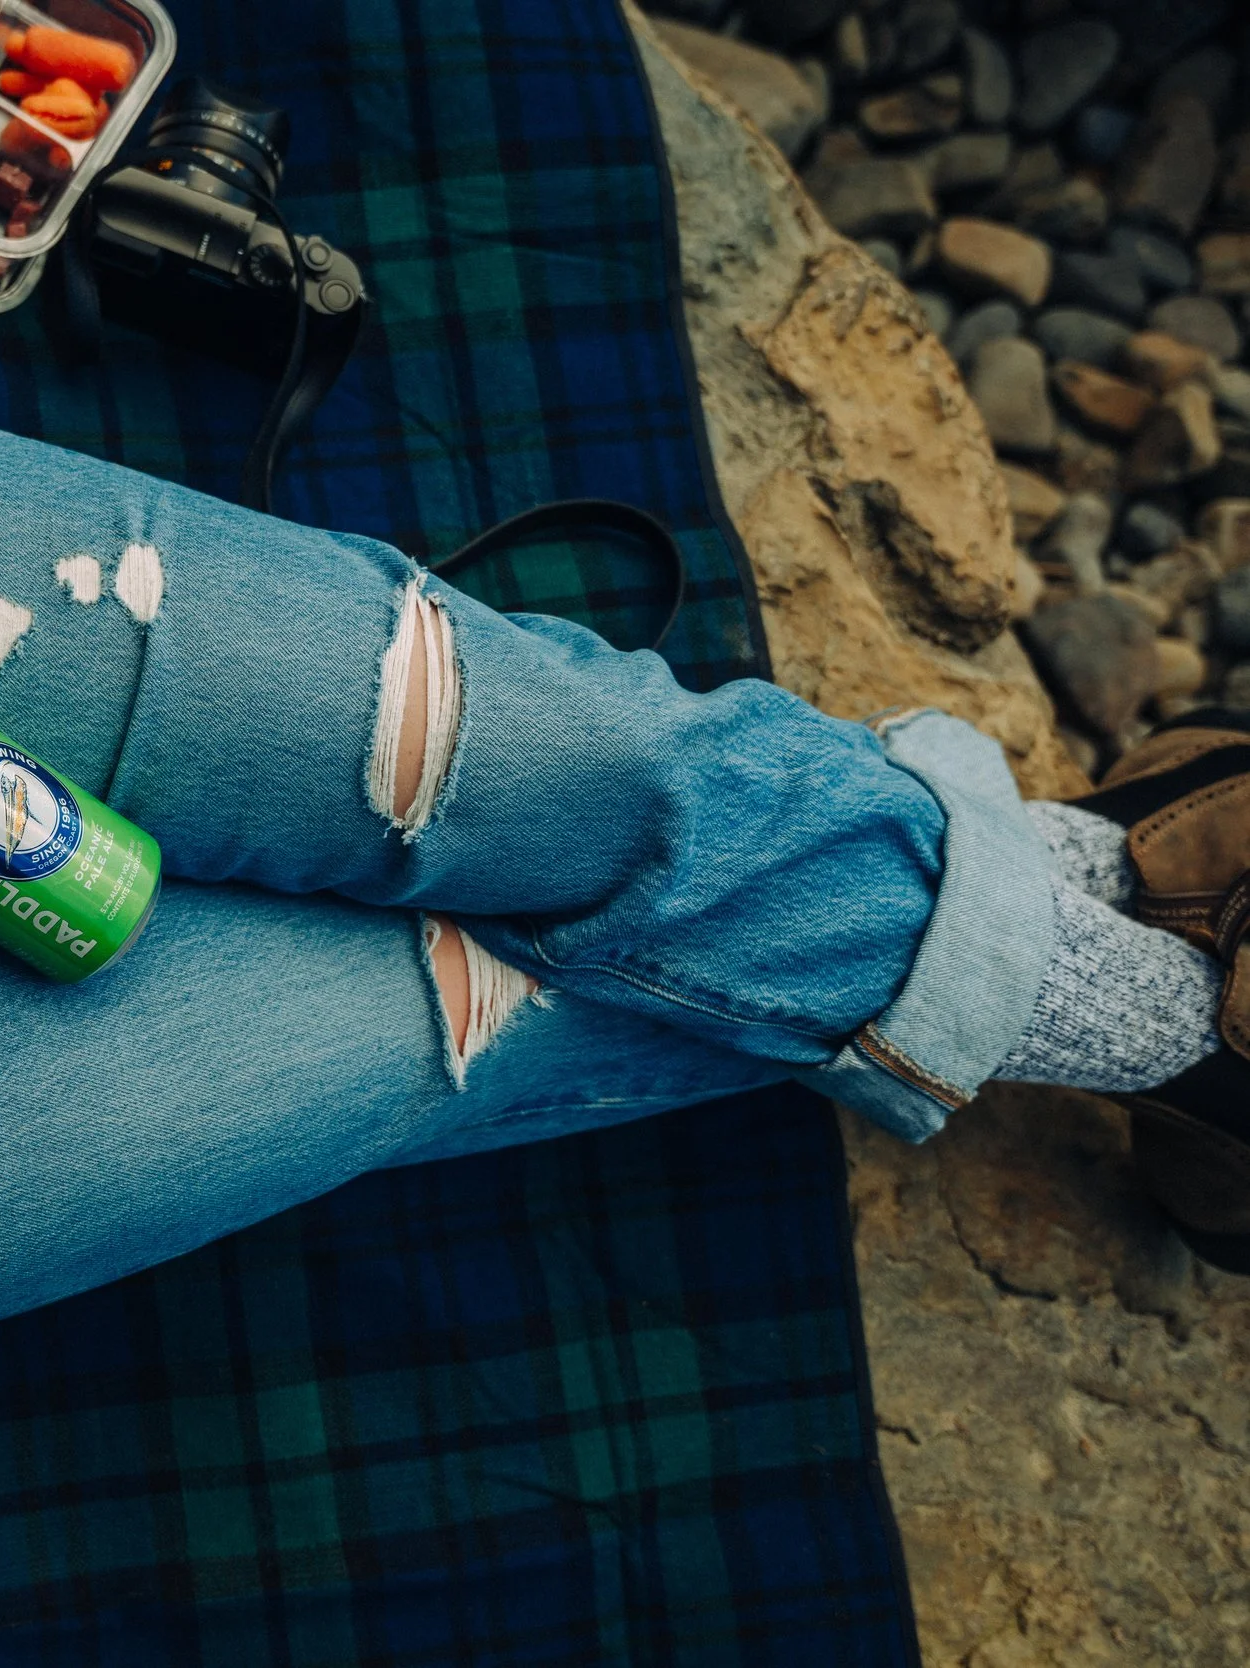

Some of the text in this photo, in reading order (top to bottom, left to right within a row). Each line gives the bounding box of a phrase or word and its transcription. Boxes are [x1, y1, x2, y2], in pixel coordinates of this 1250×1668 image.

[31, 797, 71, 863] SINCE 1996
[38, 847, 68, 870] OREGON
[65, 822, 77, 847] COAST
[75, 824, 103, 881] OCEANIC
[84, 829, 114, 891] PALE ALE
[107, 886, 130, 921] CONTENTS
